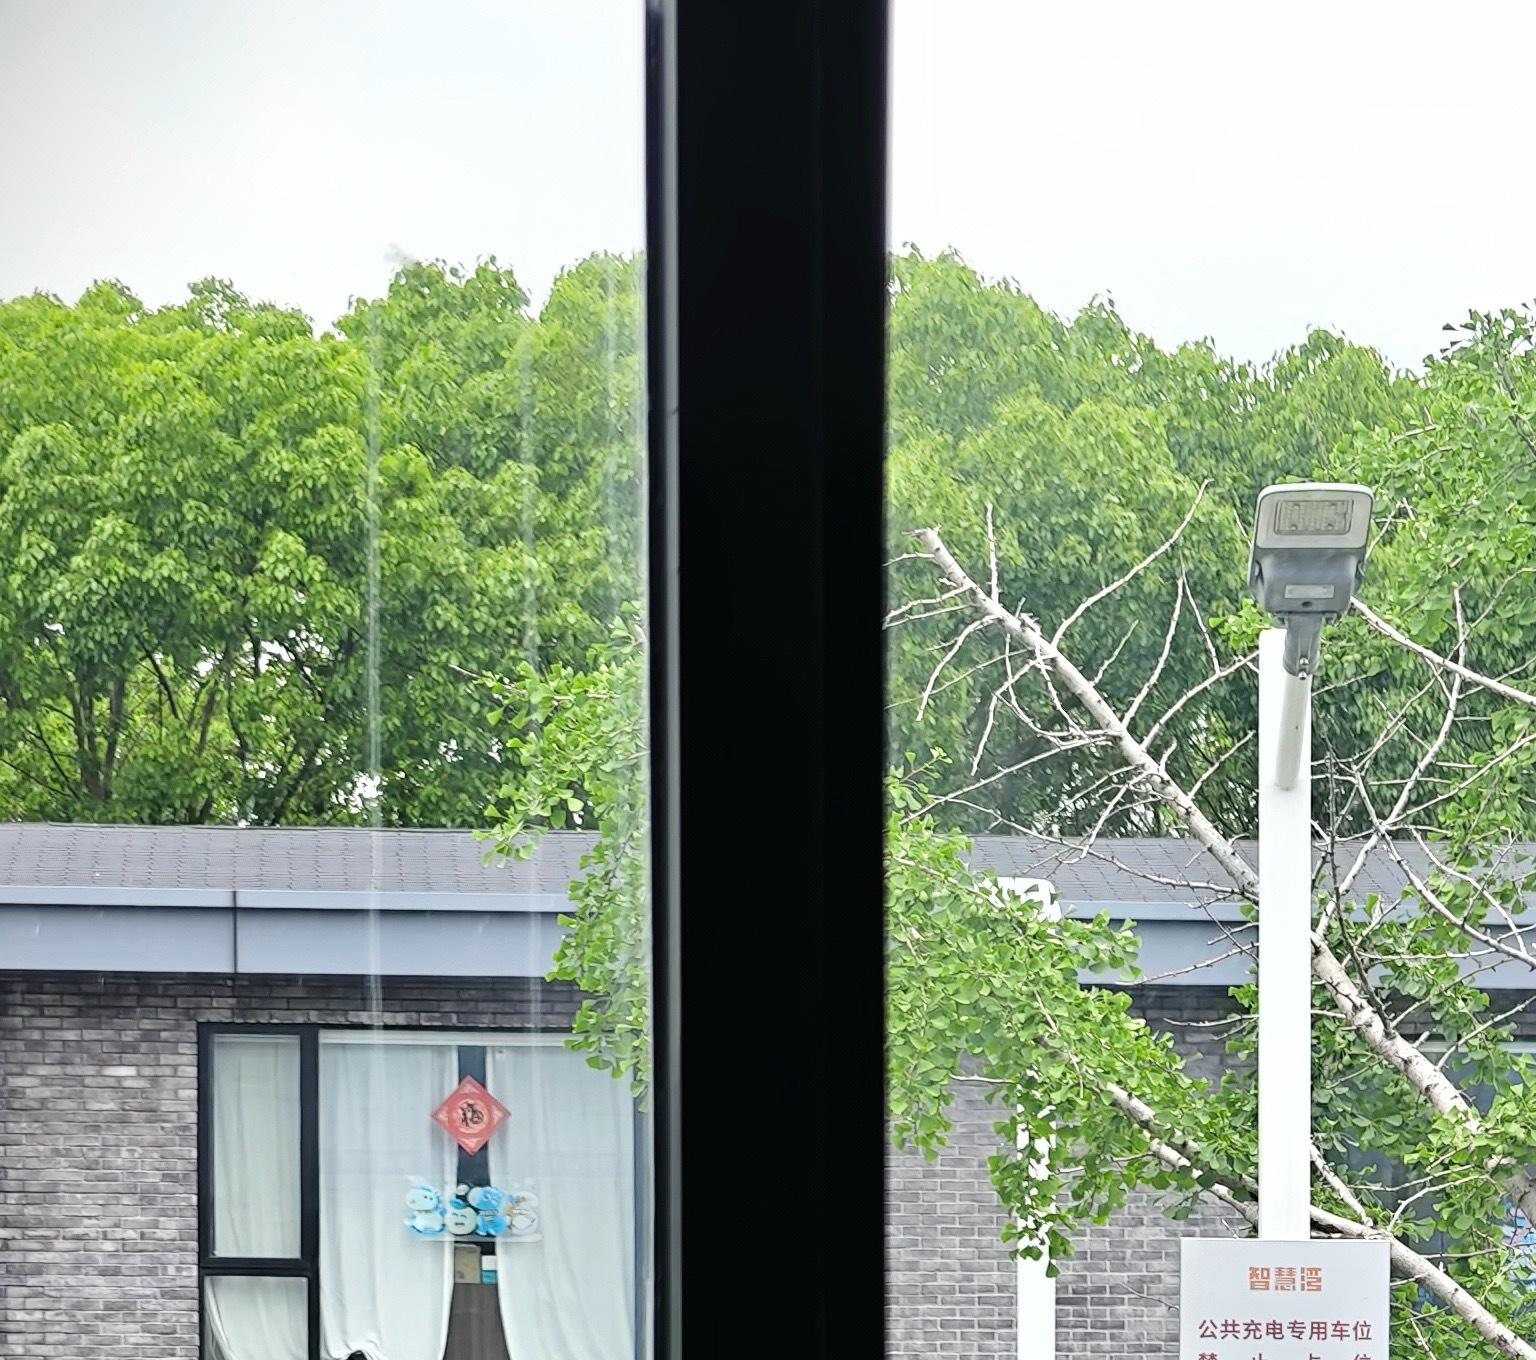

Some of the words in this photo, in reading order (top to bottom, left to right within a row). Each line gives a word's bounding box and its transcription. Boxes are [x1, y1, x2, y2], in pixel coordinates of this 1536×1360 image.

[1248, 1266, 1322, 1292] 智慧湾
[1198, 1319, 1373, 1341] 公共充电专用车位
